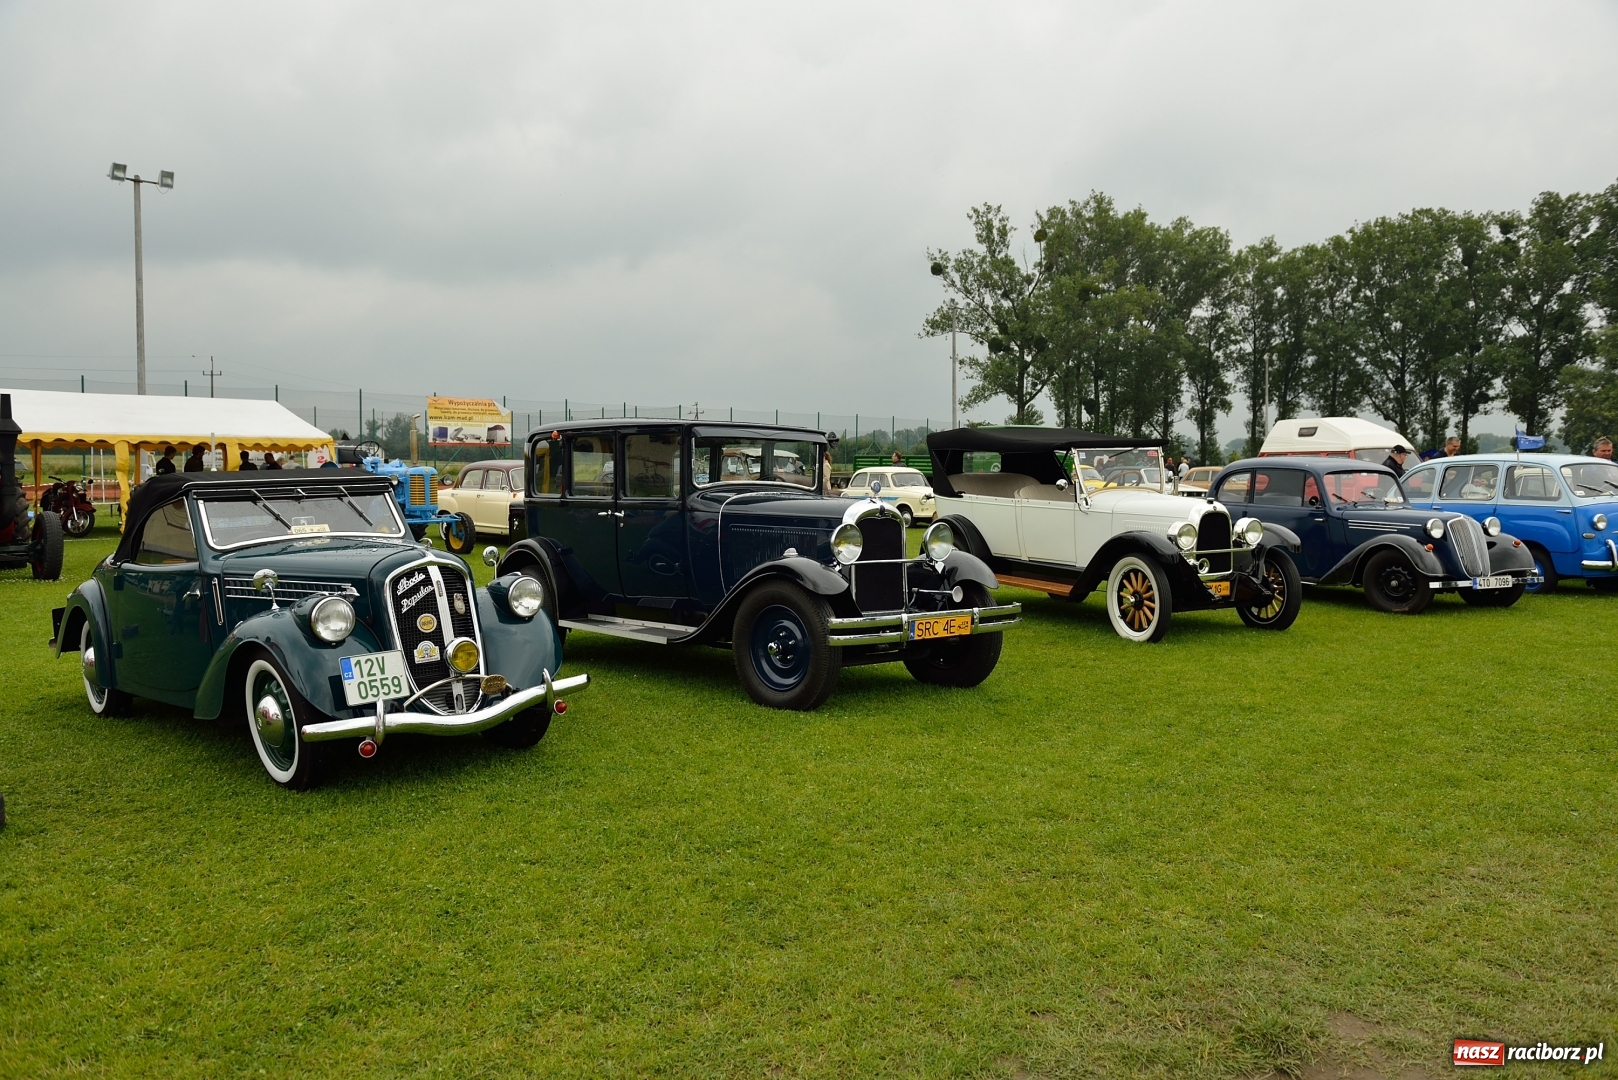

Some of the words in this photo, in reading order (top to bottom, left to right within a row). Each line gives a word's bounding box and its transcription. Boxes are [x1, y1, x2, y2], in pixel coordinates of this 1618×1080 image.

[1494, 577, 1510, 587] 7096
[401, 585, 435, 614] Popular
[916, 620, 939, 638] SRC
[943, 619, 956, 635] 4E
[354, 656, 386, 679] 12V
[357, 675, 403, 700] 0559
